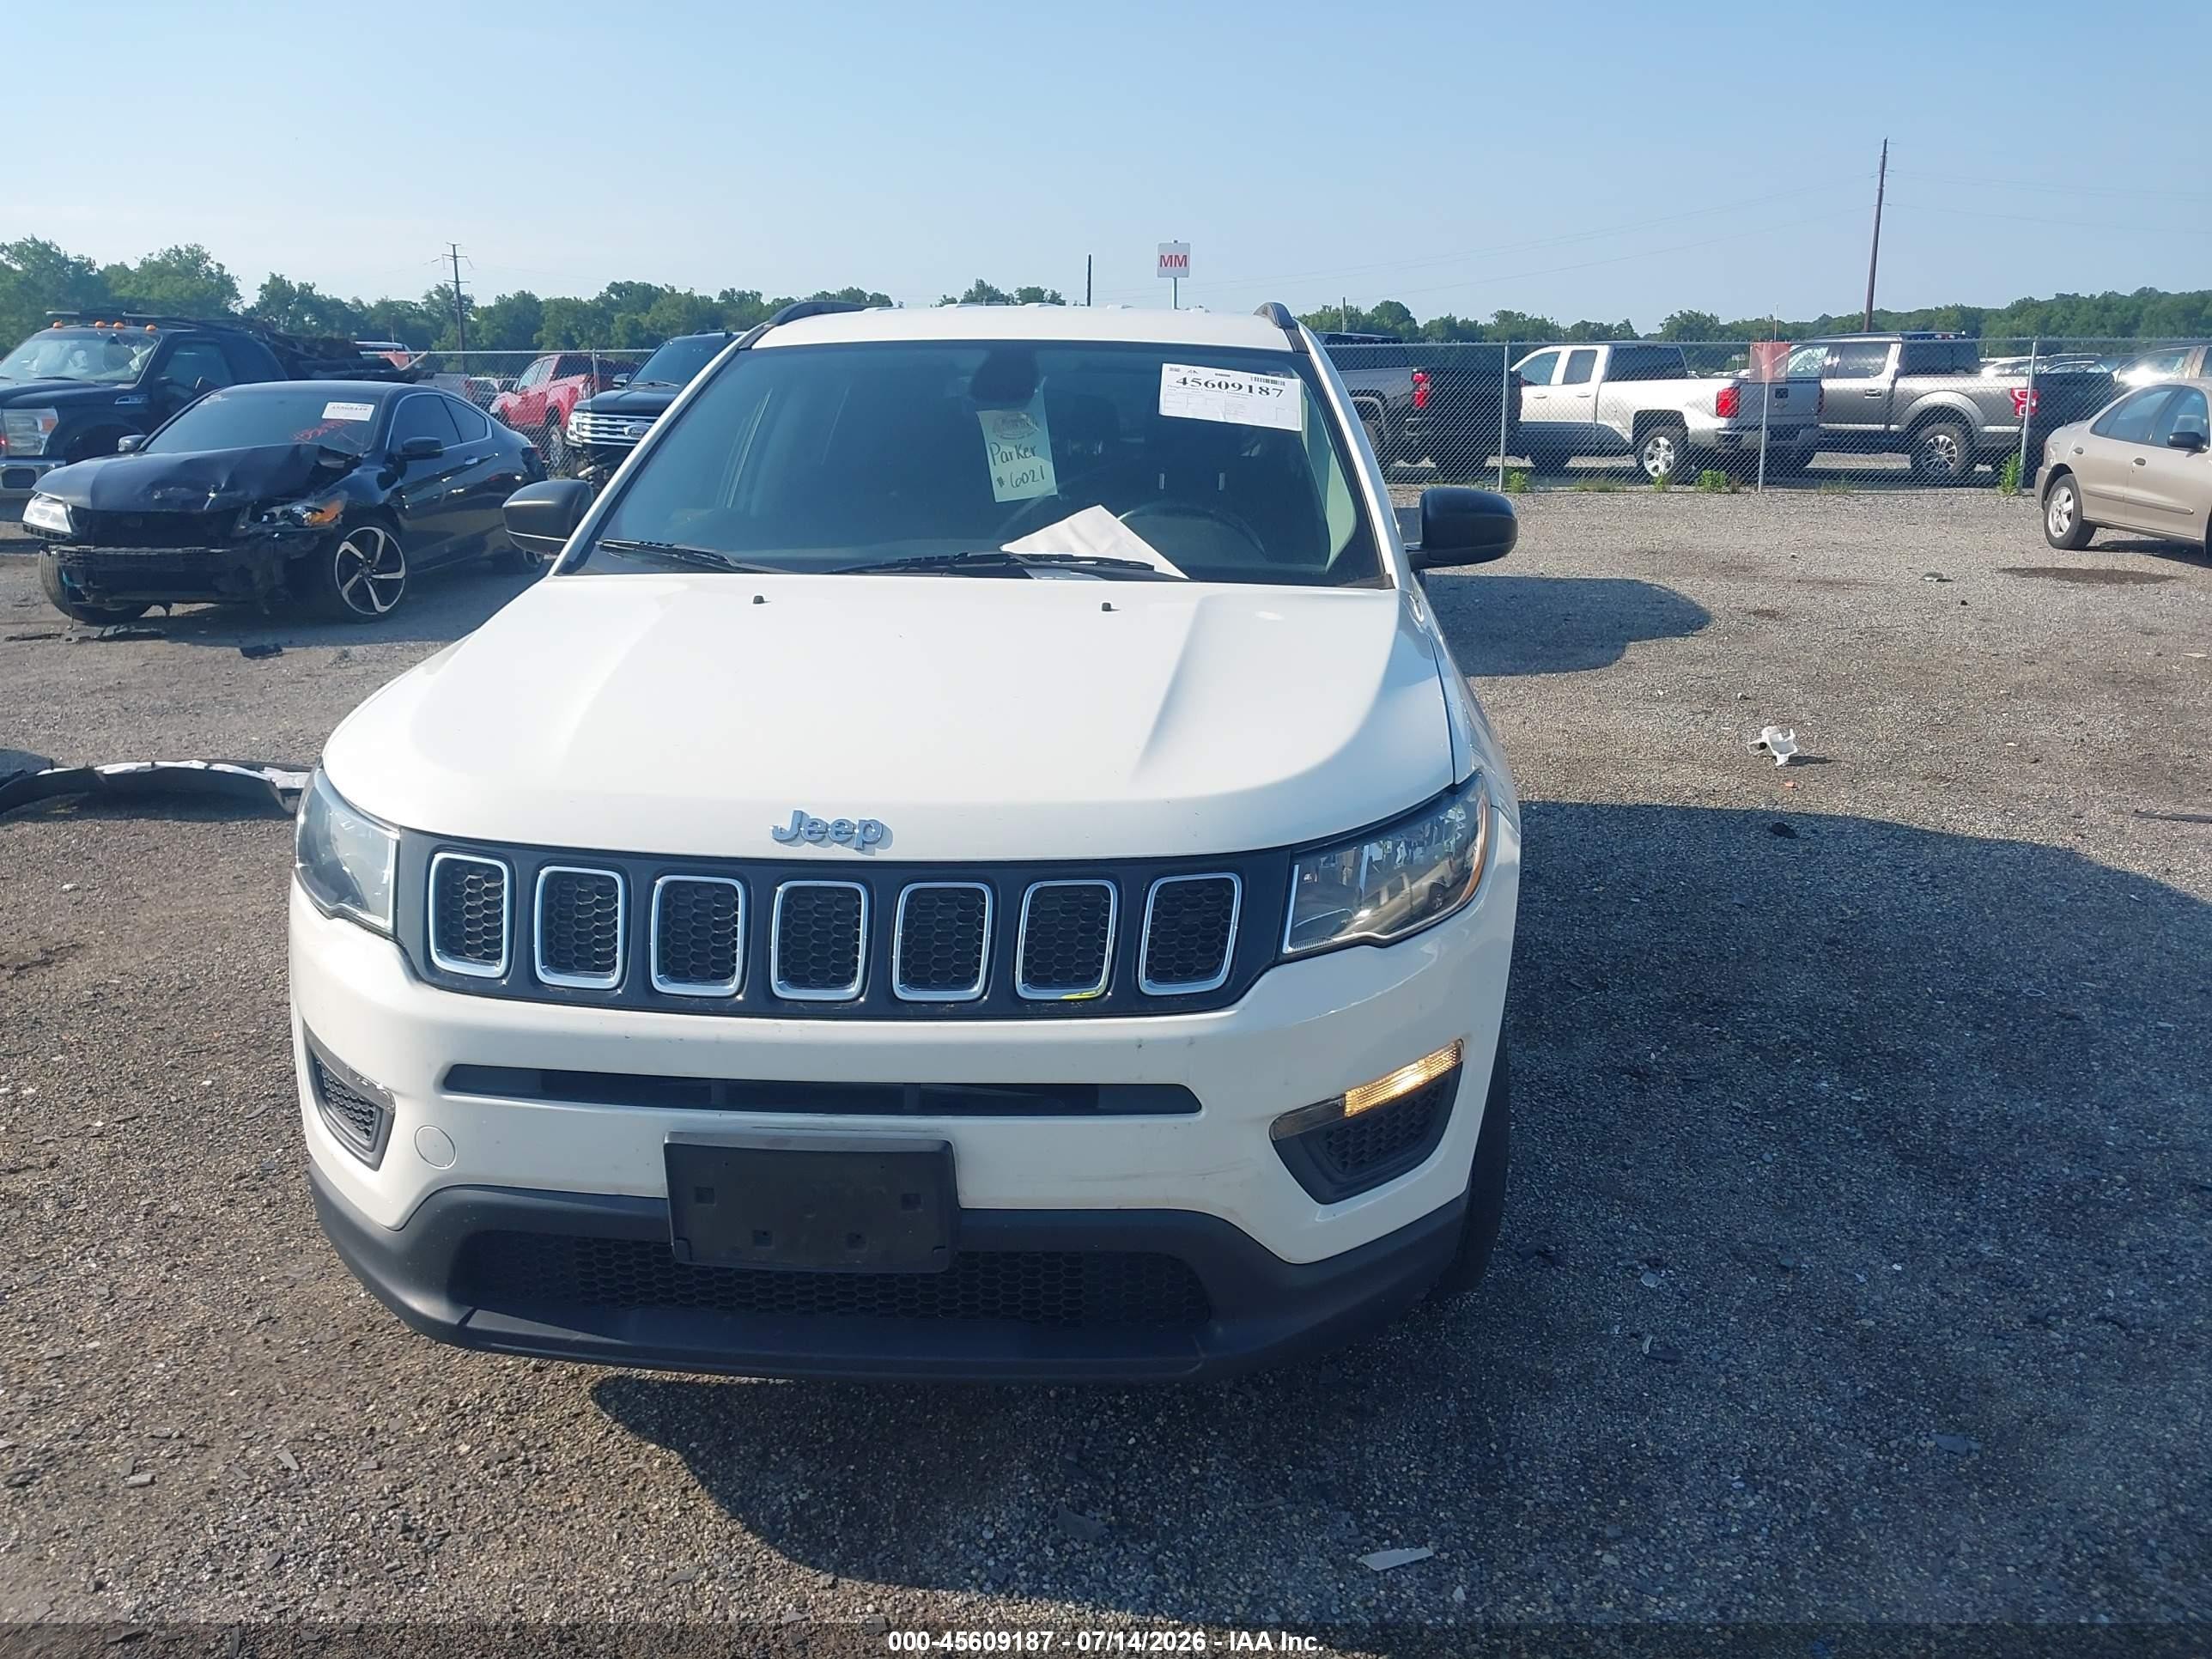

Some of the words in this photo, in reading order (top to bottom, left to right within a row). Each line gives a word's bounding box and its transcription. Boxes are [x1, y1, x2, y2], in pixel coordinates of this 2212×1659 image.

[1159, 254, 1188, 268] MM
[1176, 376, 1285, 398] 45609187
[770, 809, 884, 850] Jeep
